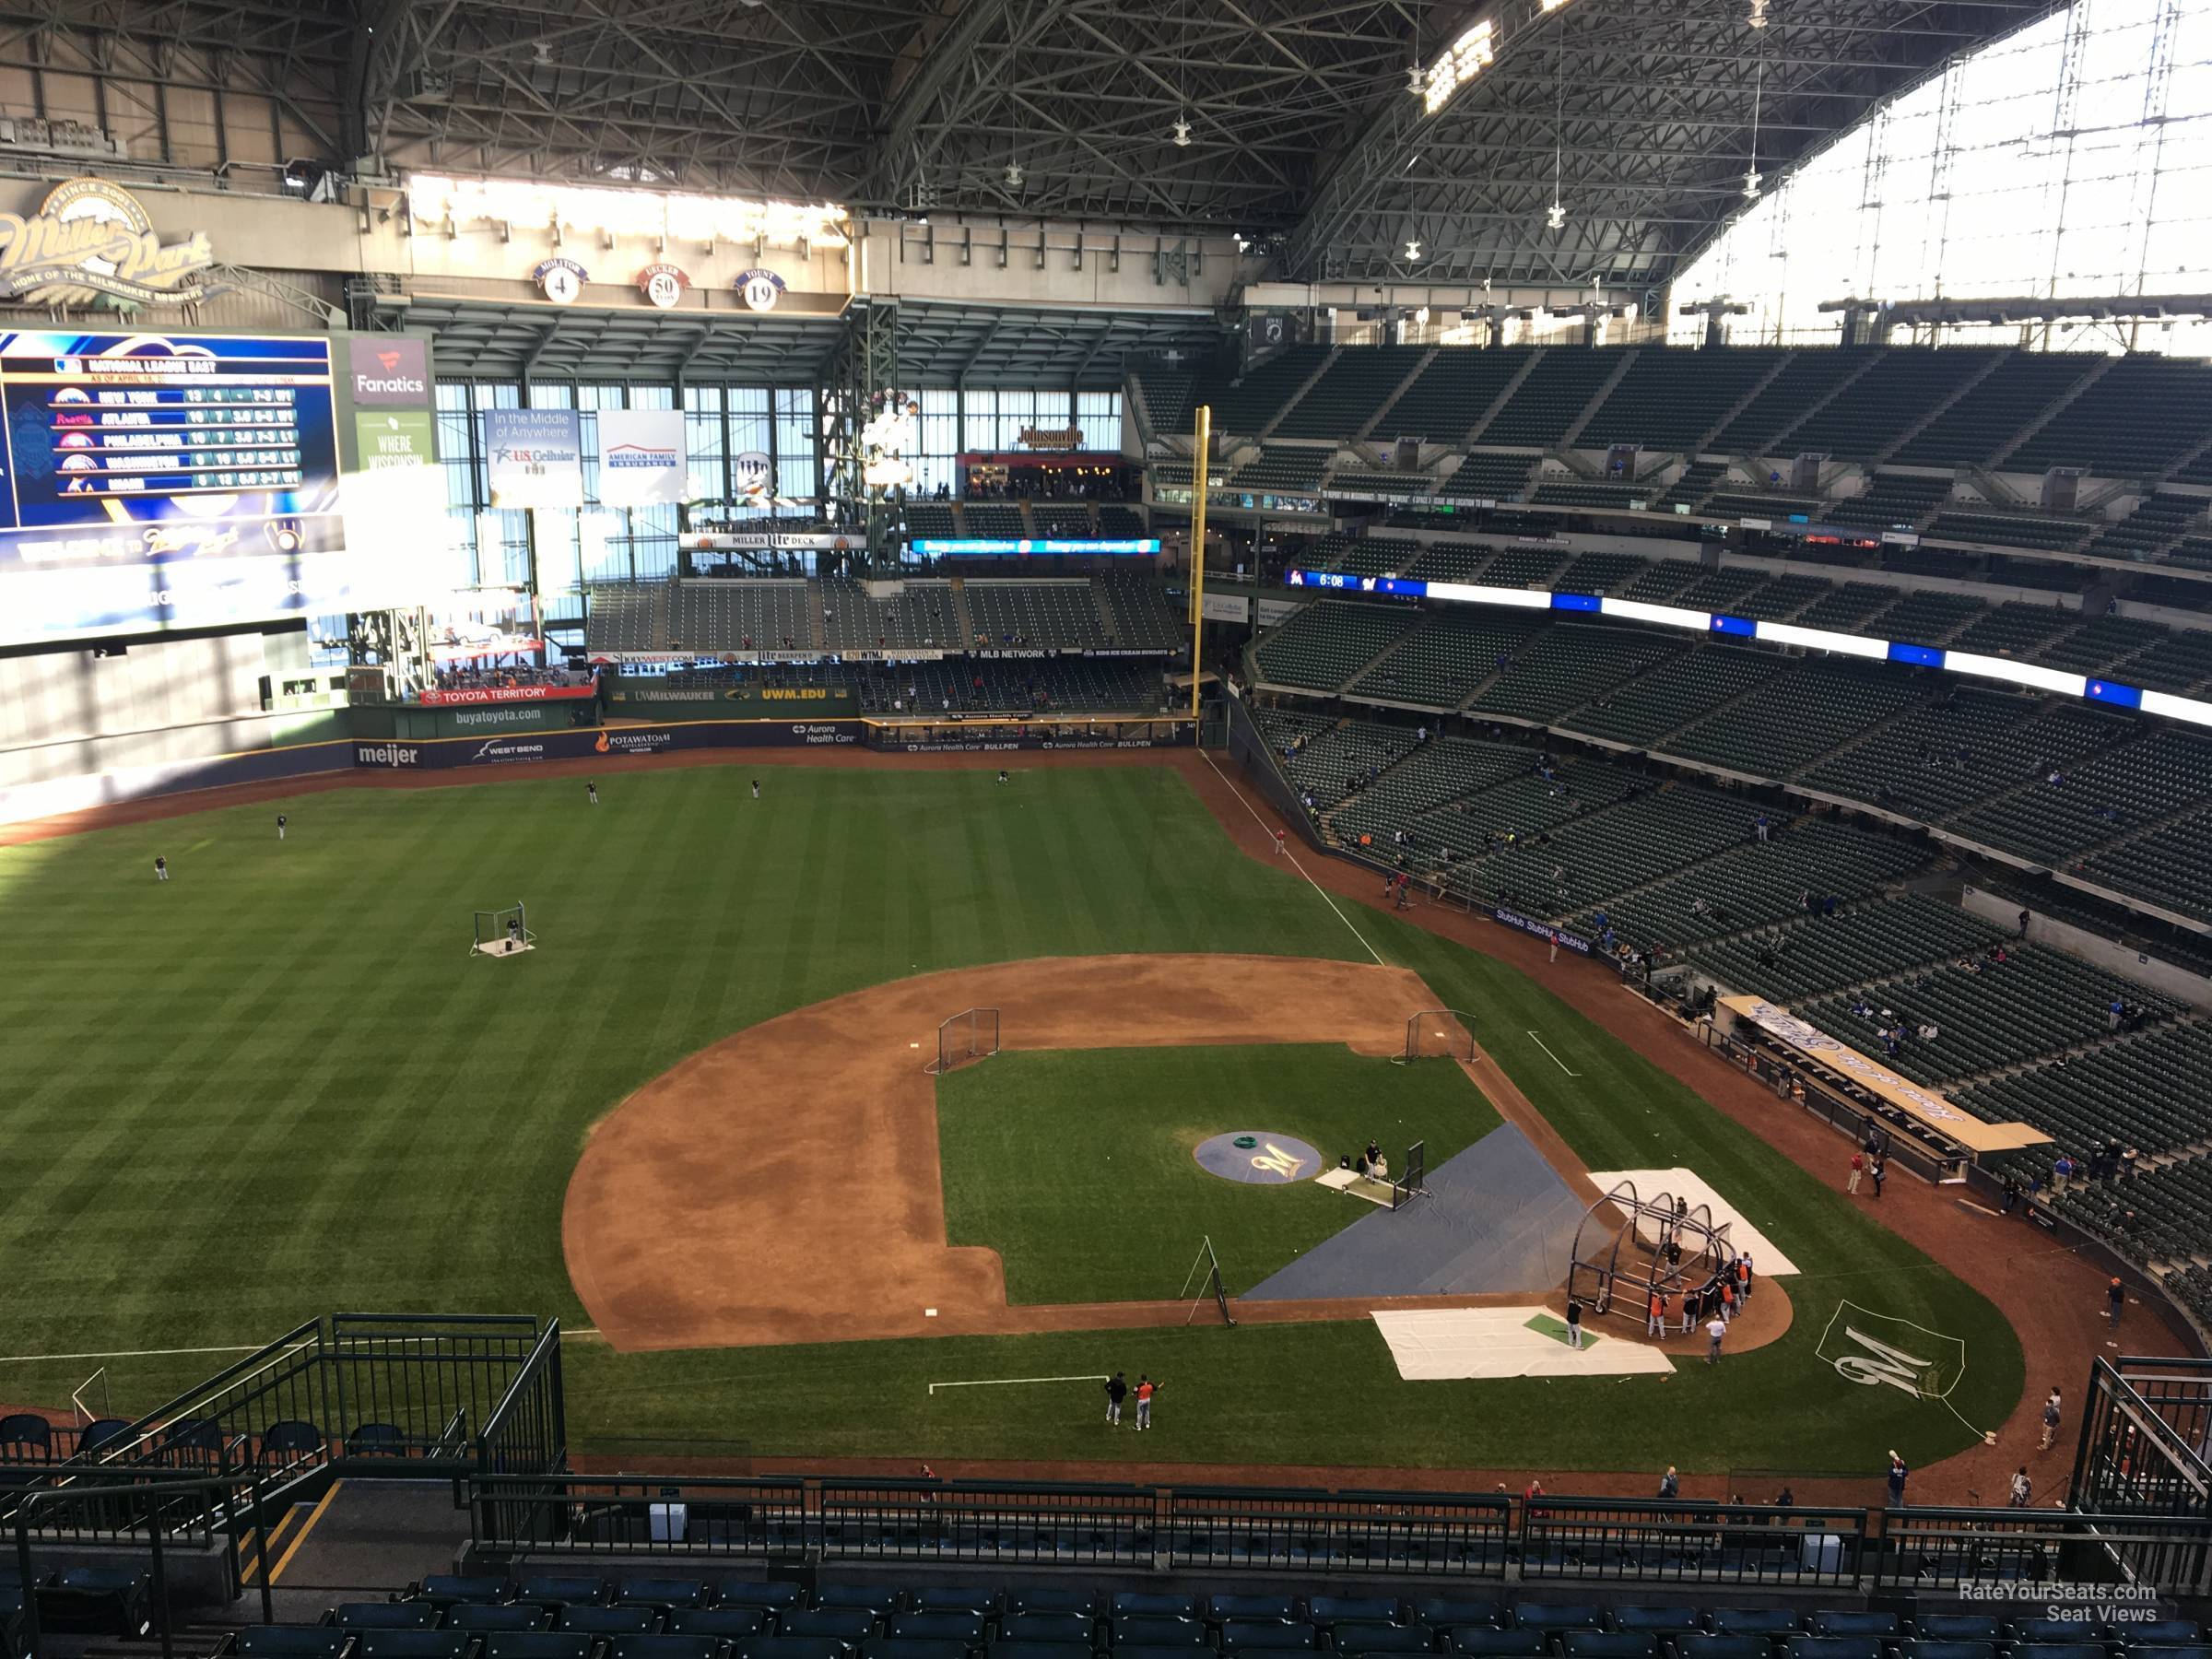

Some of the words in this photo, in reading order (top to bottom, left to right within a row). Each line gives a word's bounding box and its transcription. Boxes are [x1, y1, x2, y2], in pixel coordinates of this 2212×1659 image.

[58, 183, 97, 203] SINCE
[102, 186, 131, 205] 2001
[0, 213, 129, 269] Miller
[100, 229, 213, 281] Park
[540, 258, 582, 274] MOLITOR
[645, 264, 679, 276] UECKER
[746, 269, 775, 280] YOUNT
[12, 274, 42, 290] HOME
[44, 270, 60, 280] OF
[64, 270, 85, 284] THE
[88, 276, 153, 300] MILWAUKEE
[153, 289, 204, 303] BREWERS
[554, 276, 566, 295] 4
[654, 278, 674, 294] 50
[750, 285, 772, 303] 19
[88, 359, 145, 373] NATIONAL
[144, 360, 186, 373] LEAGUE
[188, 360, 217, 373] EAST
[357, 374, 424, 393] Fanatics
[98, 391, 125, 404] NEW
[187, 389, 202, 402] 13
[101, 412, 151, 425] ATLANTA
[495, 412, 506, 424] In
[509, 412, 528, 424] the
[531, 412, 570, 425] Middle
[497, 426, 509, 438] of
[512, 425, 569, 440] Anywhere
[1018, 425, 1084, 443] Johnsonville
[103, 434, 182, 447] PHILADELPHIA
[377, 435, 413, 453] WHERE
[105, 455, 180, 469] WASHINGTON
[367, 454, 424, 469] WISCONSIN
[533, 448, 576, 462] Cellular
[732, 536, 766, 546] MILLER
[791, 536, 816, 546] DECK
[1319, 573, 1344, 587] 6:08
[861, 650, 883, 660] WTMJ
[980, 650, 1000, 659] MLB
[1001, 650, 1045, 659] NETWORK
[443, 691, 488, 703] TOYOTA
[490, 688, 547, 700] TERRITORY
[761, 689, 827, 700] UWM.EDU
[455, 709, 542, 726] buyatoyota.com
[807, 725, 836, 734] Aurora
[609, 734, 671, 746] POTAWATOMI
[806, 734, 834, 744] Health
[835, 734, 855, 743] Care
[359, 743, 418, 767] meijer
[488, 746, 516, 755] WEST
[516, 744, 544, 753] BEND
[1496, 909, 1525, 927] StubHub
[1559, 933, 1589, 952] StubHub
